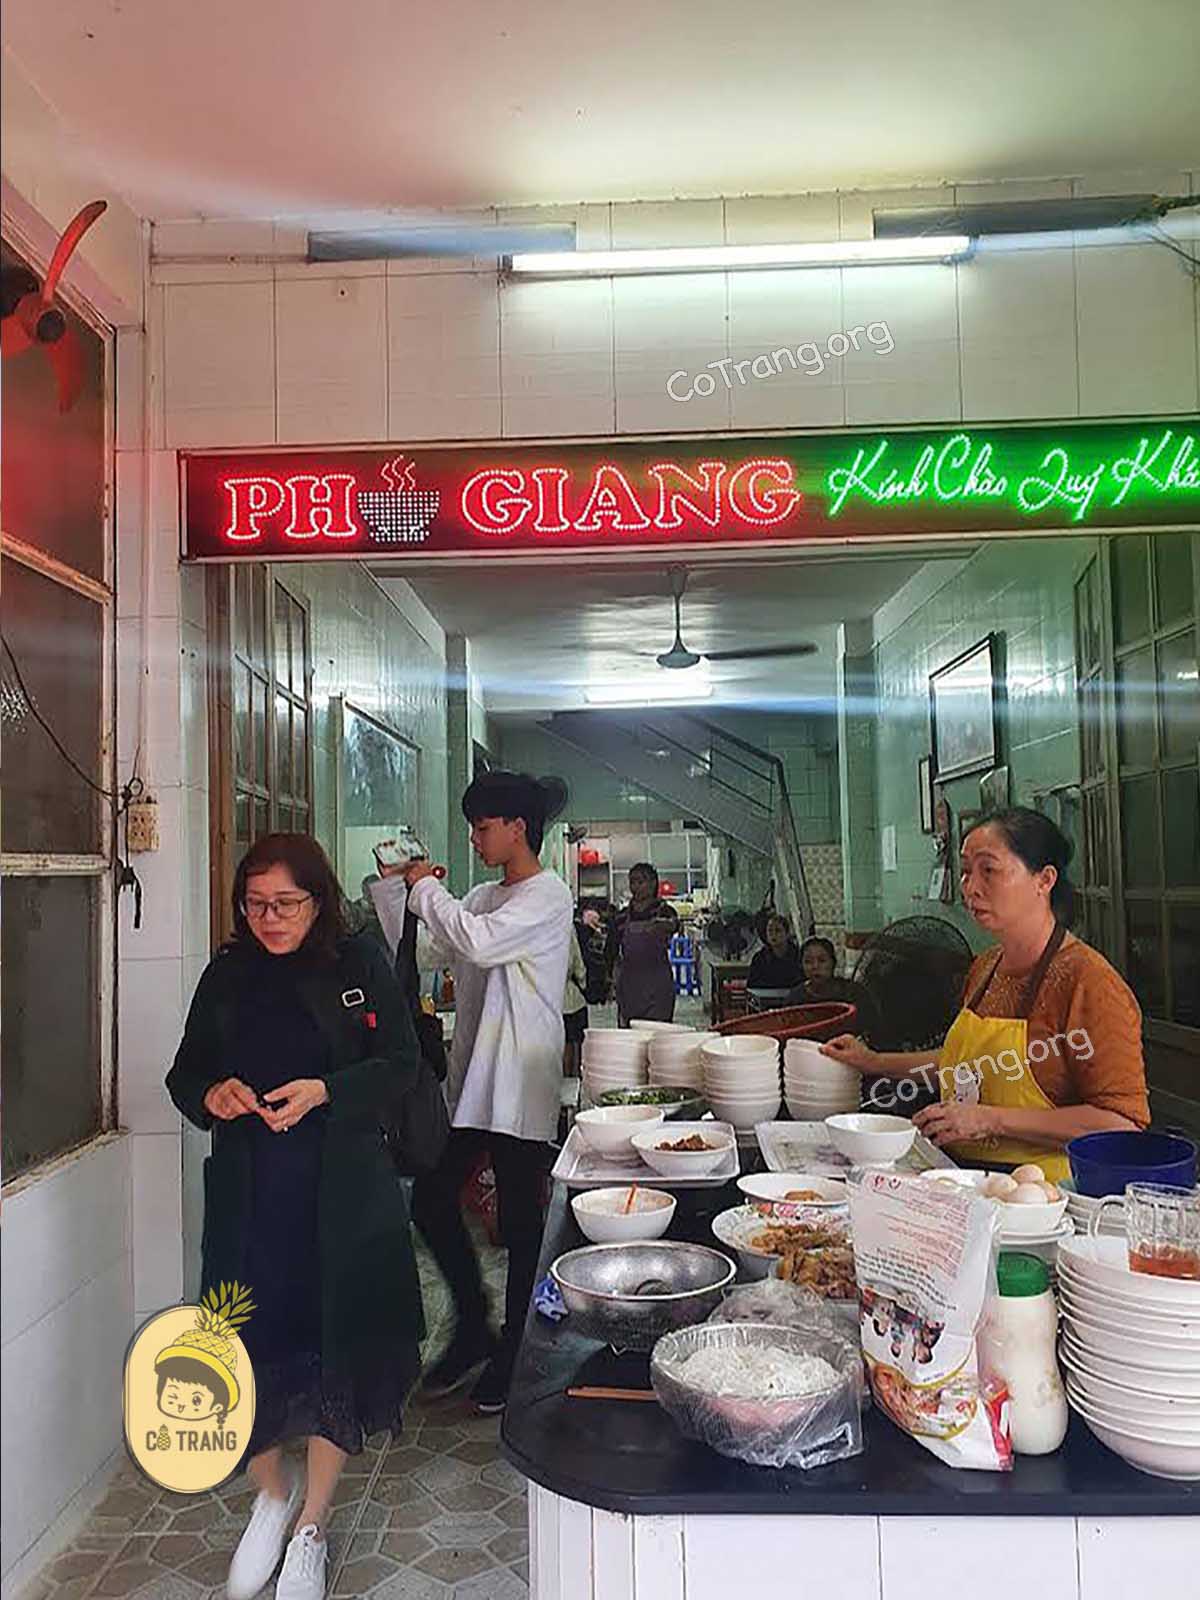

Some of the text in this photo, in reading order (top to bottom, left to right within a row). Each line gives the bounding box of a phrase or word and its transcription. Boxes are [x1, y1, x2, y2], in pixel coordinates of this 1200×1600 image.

[462, 460, 801, 534] GIANG
[828, 440, 934, 515] Kính
[934, 434, 1008, 499] Chào
[1018, 448, 1105, 520] Quý
